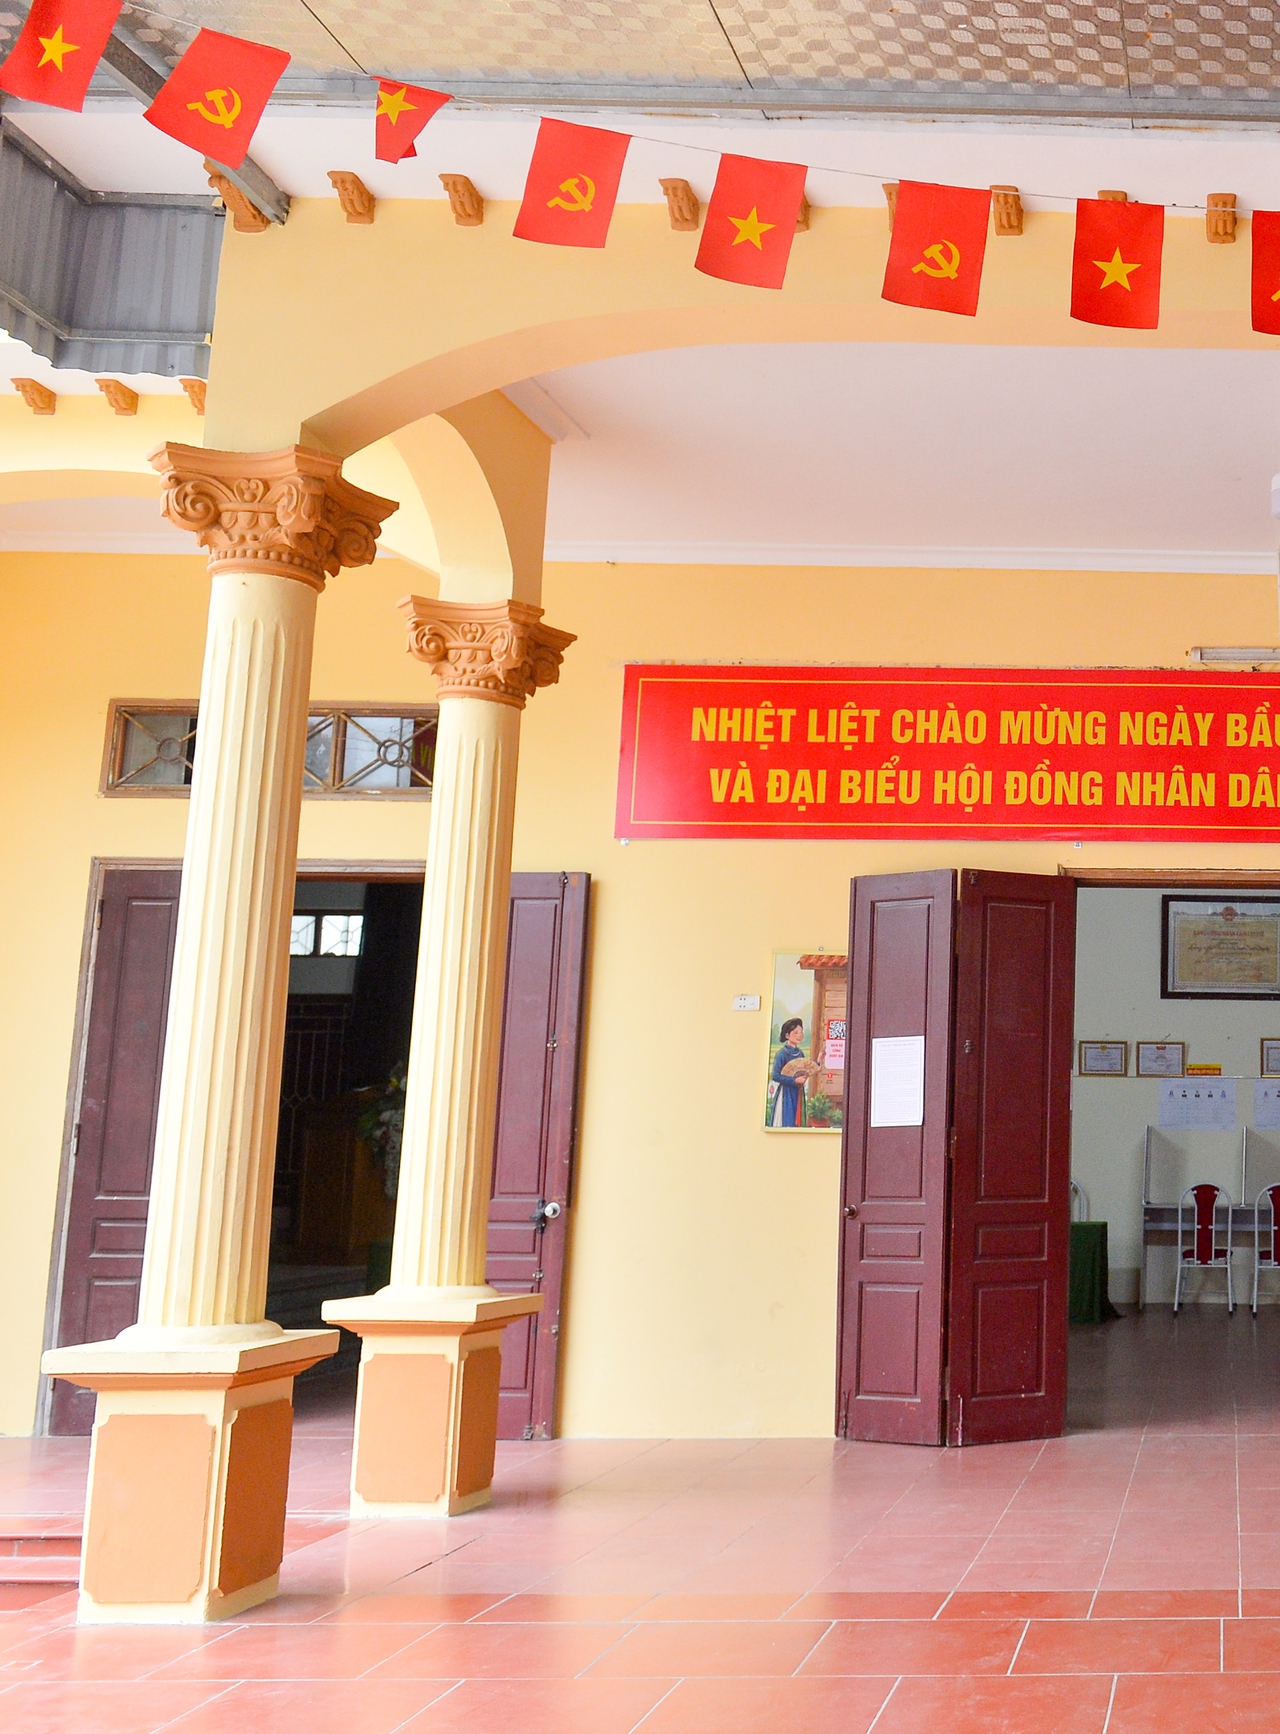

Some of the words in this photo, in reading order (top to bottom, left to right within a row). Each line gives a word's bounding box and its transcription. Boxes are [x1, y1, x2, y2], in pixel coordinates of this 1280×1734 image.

[692, 701, 796, 749] NHIỆT
[808, 702, 880, 750] LIỆT
[892, 703, 986, 744] CHÀO
[1000, 704, 1106, 745] MỪNG
[1120, 705, 1214, 747] NGÀY
[710, 761, 754, 803] VÀ
[766, 769, 826, 811] ĐẠI
[840, 756, 920, 805] BIỂU
[934, 763, 992, 812] HỘI
[1005, 759, 1102, 806] ĐỒNG
[1116, 765, 1215, 807] NHÂN
